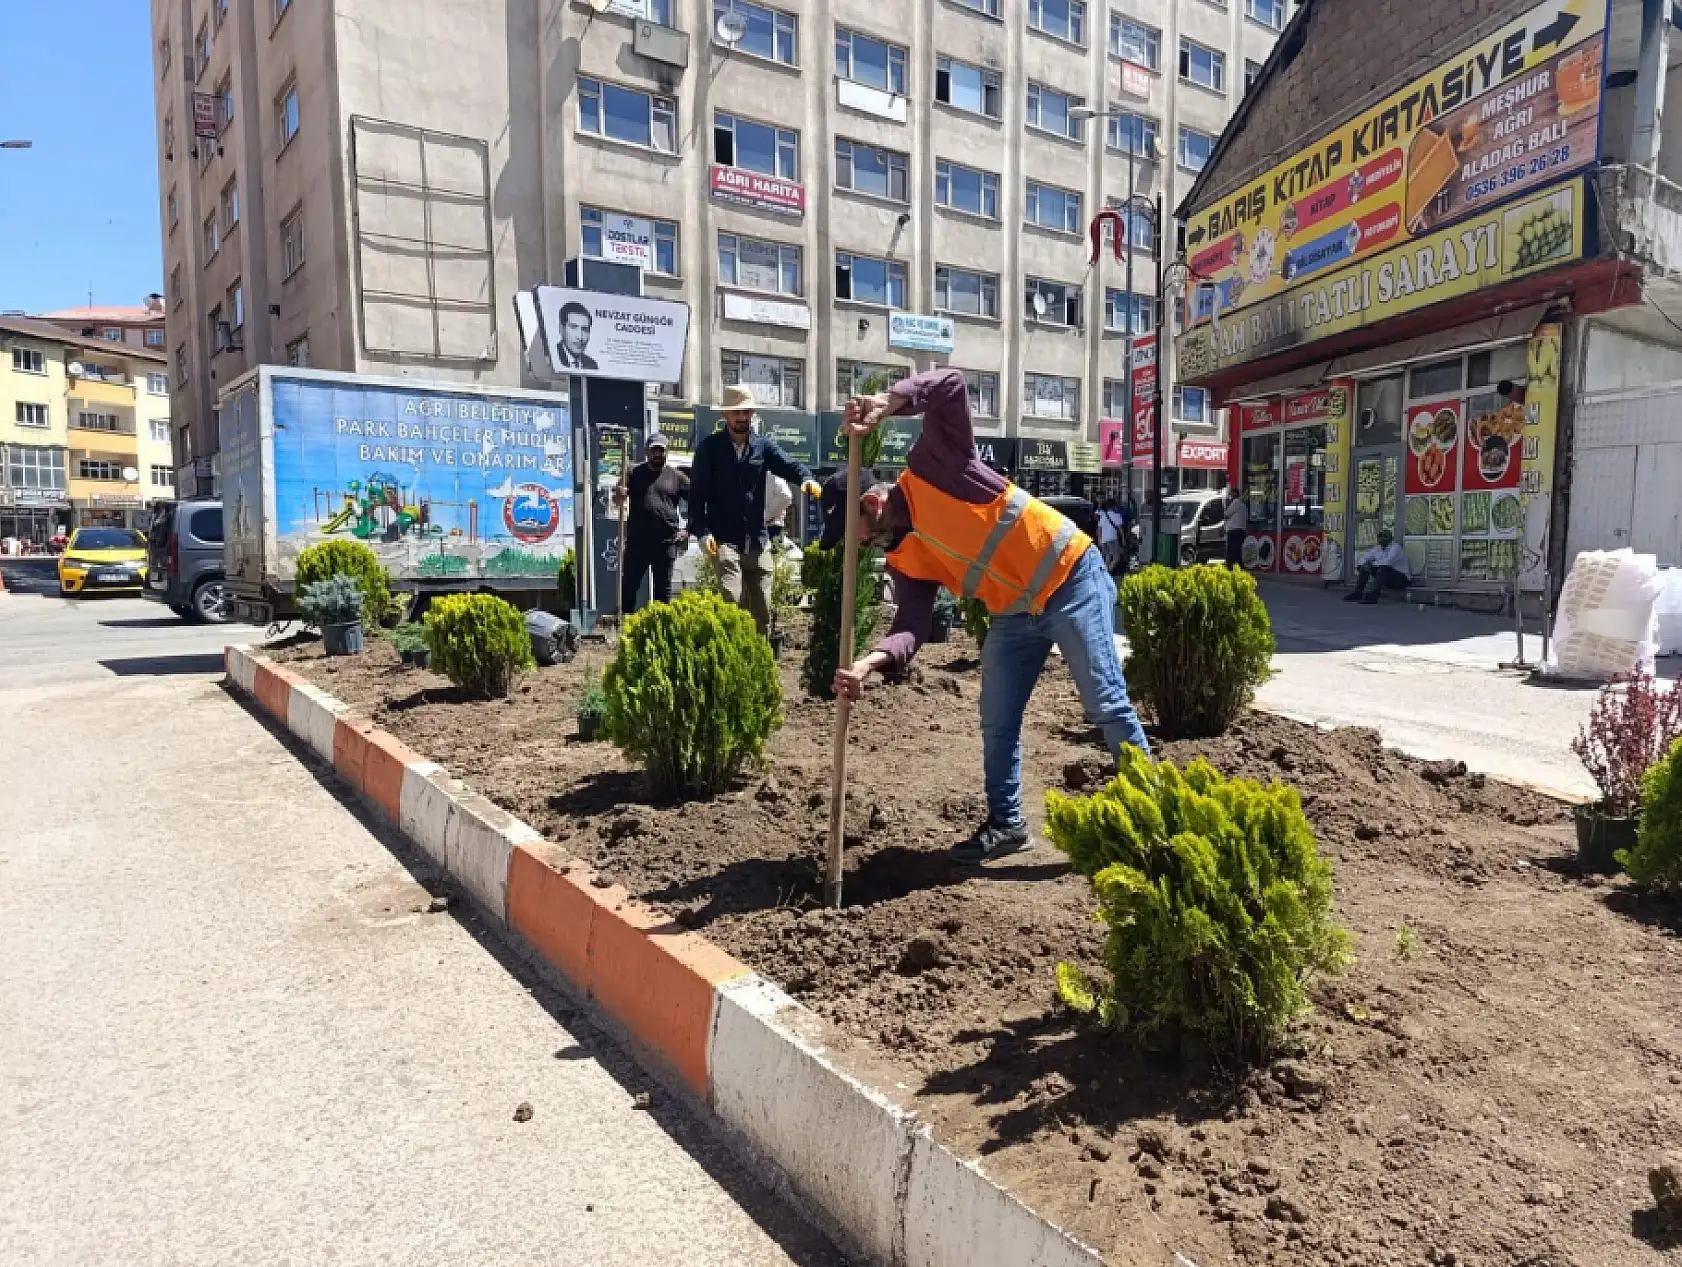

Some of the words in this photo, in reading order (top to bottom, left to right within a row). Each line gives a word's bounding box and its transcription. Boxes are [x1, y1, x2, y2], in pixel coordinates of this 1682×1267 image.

[1481, 70, 1551, 122] MEŞHUR
[1208, 184, 1266, 241] BARIŞ
[1274, 140, 1343, 206] KİTAP
[1352, 27, 1527, 163] KIRTASİYE
[1527, 119, 1568, 152] BALI
[1465, 180, 1498, 202] 0536
[1501, 164, 1526, 188] 396
[1530, 155, 1546, 175] 26
[1301, 270, 1372, 329] TATLI
[1378, 222, 1500, 304] SARAYI
[595, 308, 632, 322] NEVZAT
[633, 311, 674, 327] GÜNGÖR
[615, 322, 656, 336] CADDESİ
[404, 397, 451, 419] AĞRI
[336, 418, 393, 438] PARK
[398, 422, 493, 445] BAHÇELER
[360, 444, 424, 463] BAKIM
[431, 448, 455, 465] VE
[462, 451, 537, 469] ONARIM
[1180, 443, 1228, 462] EXPORT
